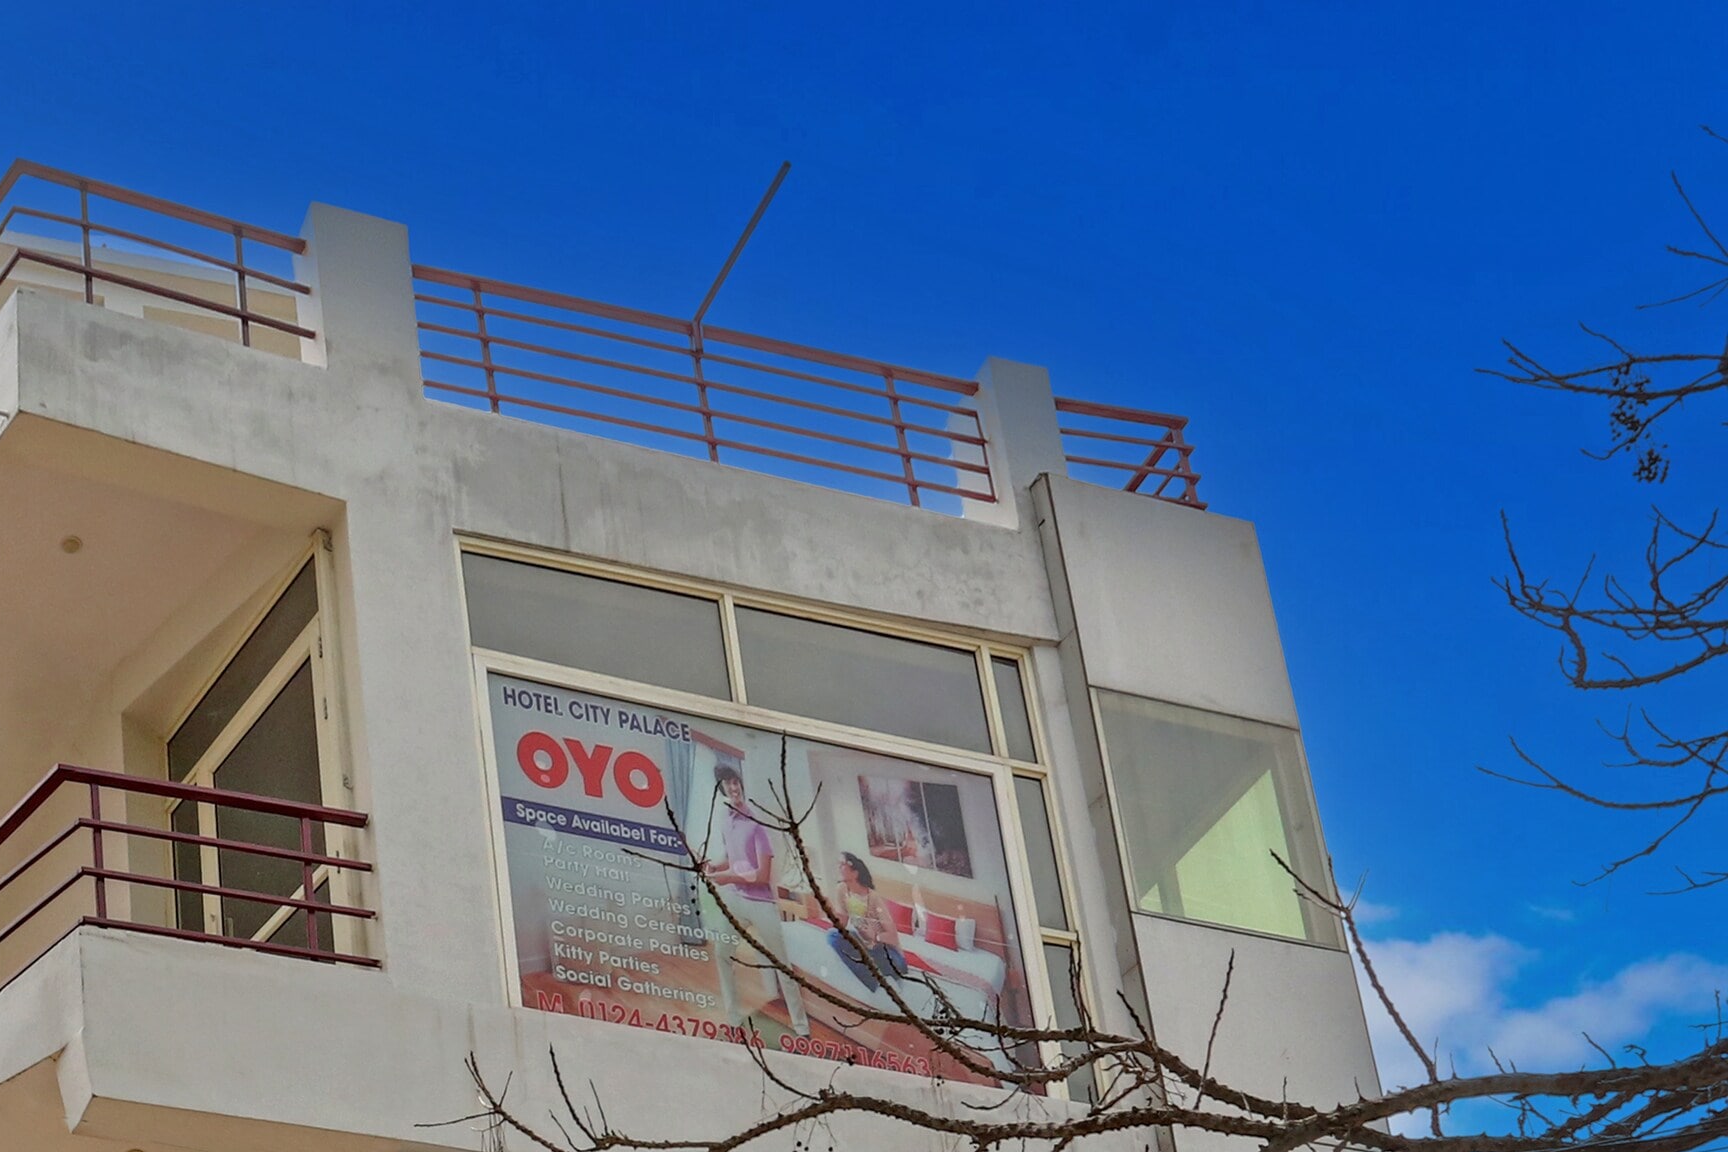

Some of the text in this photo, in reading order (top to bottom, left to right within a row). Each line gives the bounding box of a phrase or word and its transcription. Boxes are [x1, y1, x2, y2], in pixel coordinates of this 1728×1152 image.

[502, 685, 691, 742] HOTEL CITY PALACE
[517, 731, 664, 808] OYO
[515, 803, 567, 826] Space
[572, 814, 645, 841] Availabel
[543, 855, 589, 878] Party
[583, 845, 642, 868] Rooms
[545, 875, 691, 915] Wedding Parties
[548, 897, 740, 946] Wedding Ceremonies
[551, 920, 709, 962] Corporate Parties
[553, 943, 660, 974] Kitty Parties
[555, 966, 716, 1009] Social Gatherings
